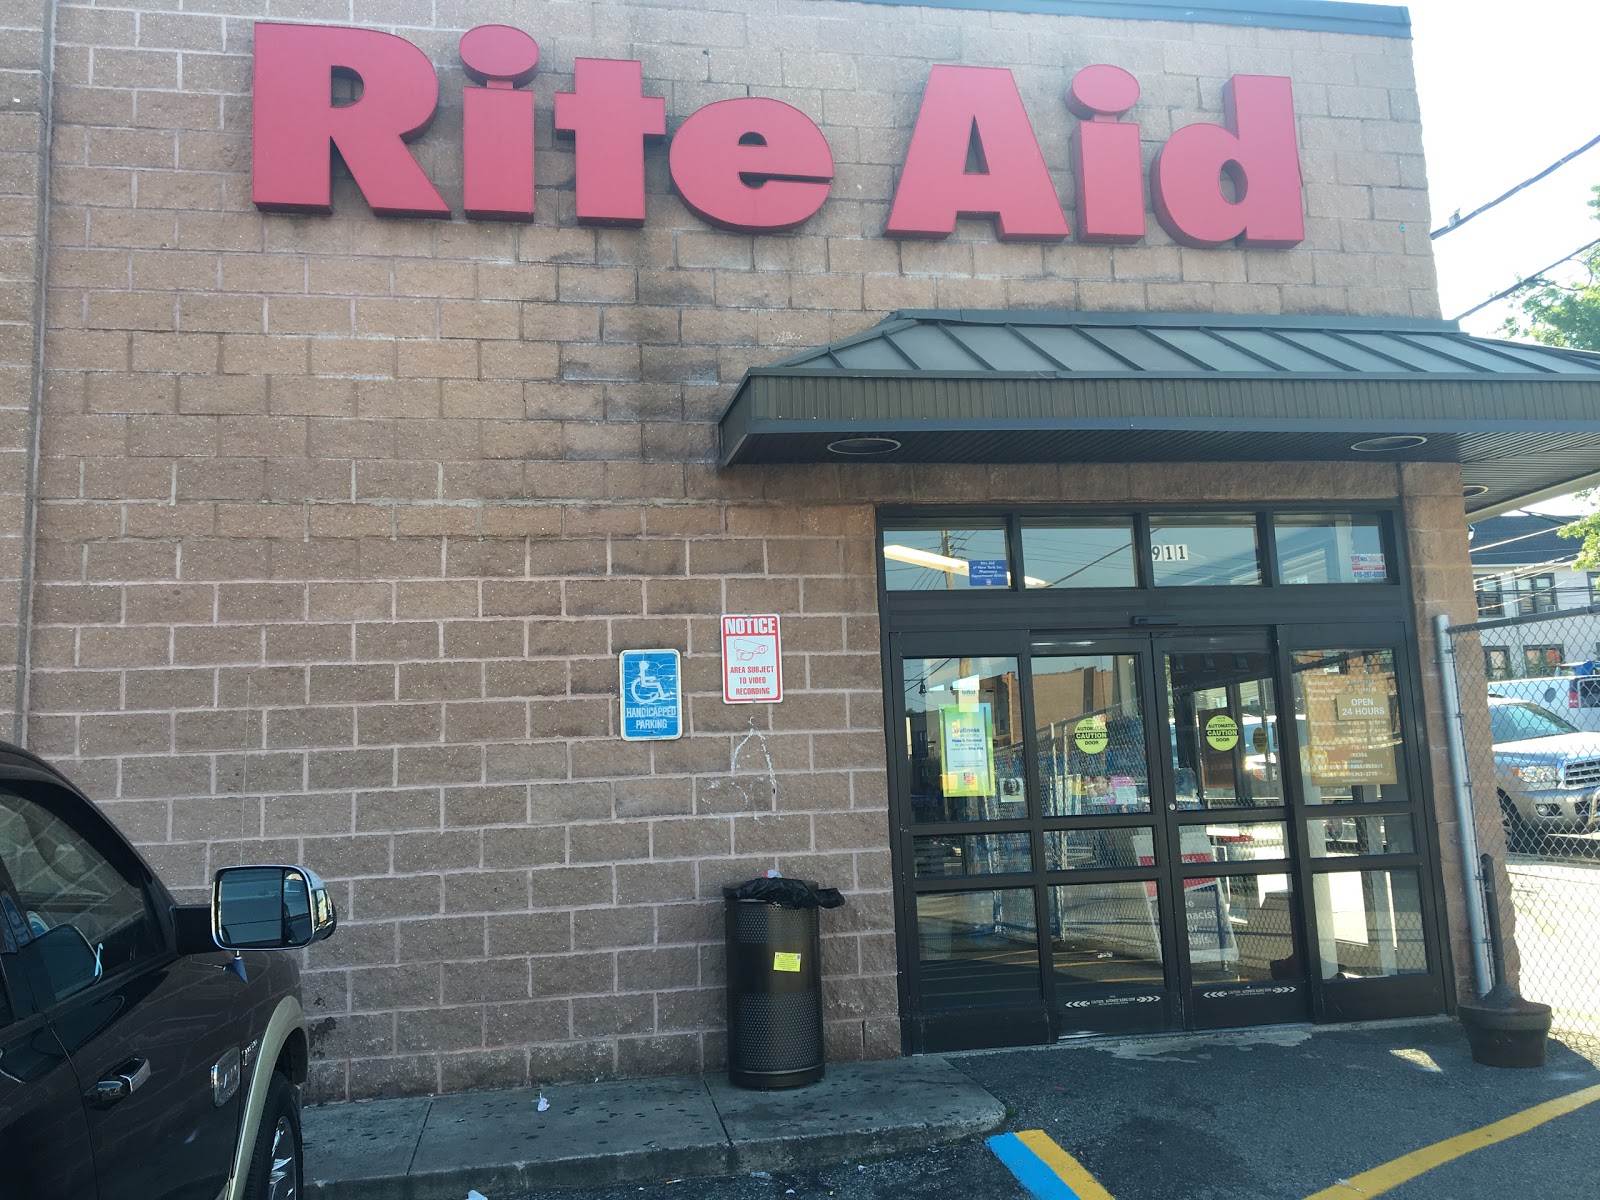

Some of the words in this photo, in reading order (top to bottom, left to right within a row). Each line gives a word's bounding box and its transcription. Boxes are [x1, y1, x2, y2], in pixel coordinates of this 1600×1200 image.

[252, 22, 834, 233] Rite
[883, 64, 1305, 248] Aid
[1152, 545, 1186, 560] 911
[725, 617, 776, 634] NOTICE
[748, 666, 774, 674] SUBJECT
[735, 687, 770, 695] RECORDING
[1351, 698, 1374, 706] OPEN
[626, 706, 677, 717] HANDICAPPED
[1342, 708, 1353, 716] 24
[1355, 707, 1385, 715] HOURS
[636, 719, 668, 729] PARKING
[1189, 934, 1213, 945] tails.
